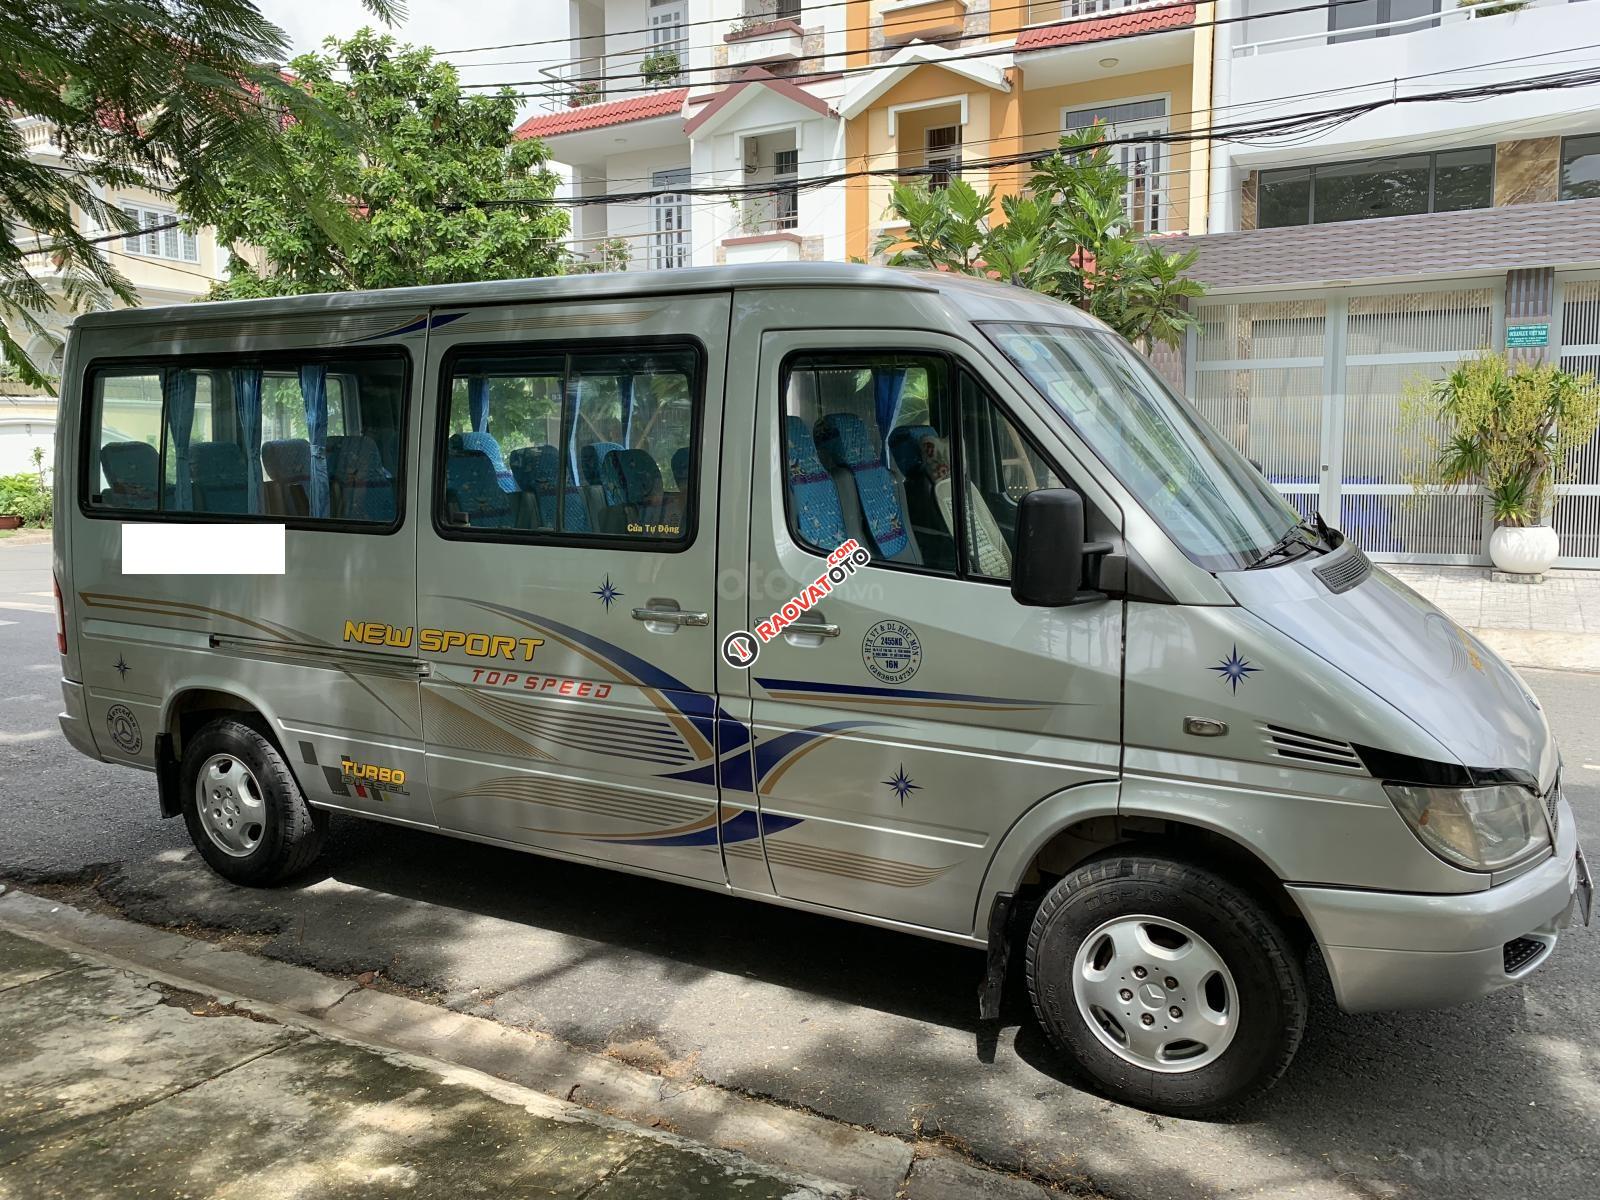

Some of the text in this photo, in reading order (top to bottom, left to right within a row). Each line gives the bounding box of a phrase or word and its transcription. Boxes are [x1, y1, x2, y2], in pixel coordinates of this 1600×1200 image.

[627, 523, 680, 534] Cửa Tự Động
[343, 619, 546, 662] NEW SPORT
[865, 638, 873, 653] HTX
[885, 660, 899, 669] 16N
[471, 668, 613, 699] TOP SPEED
[341, 760, 405, 785] TURBO
[341, 774, 410, 796] DIESEL
